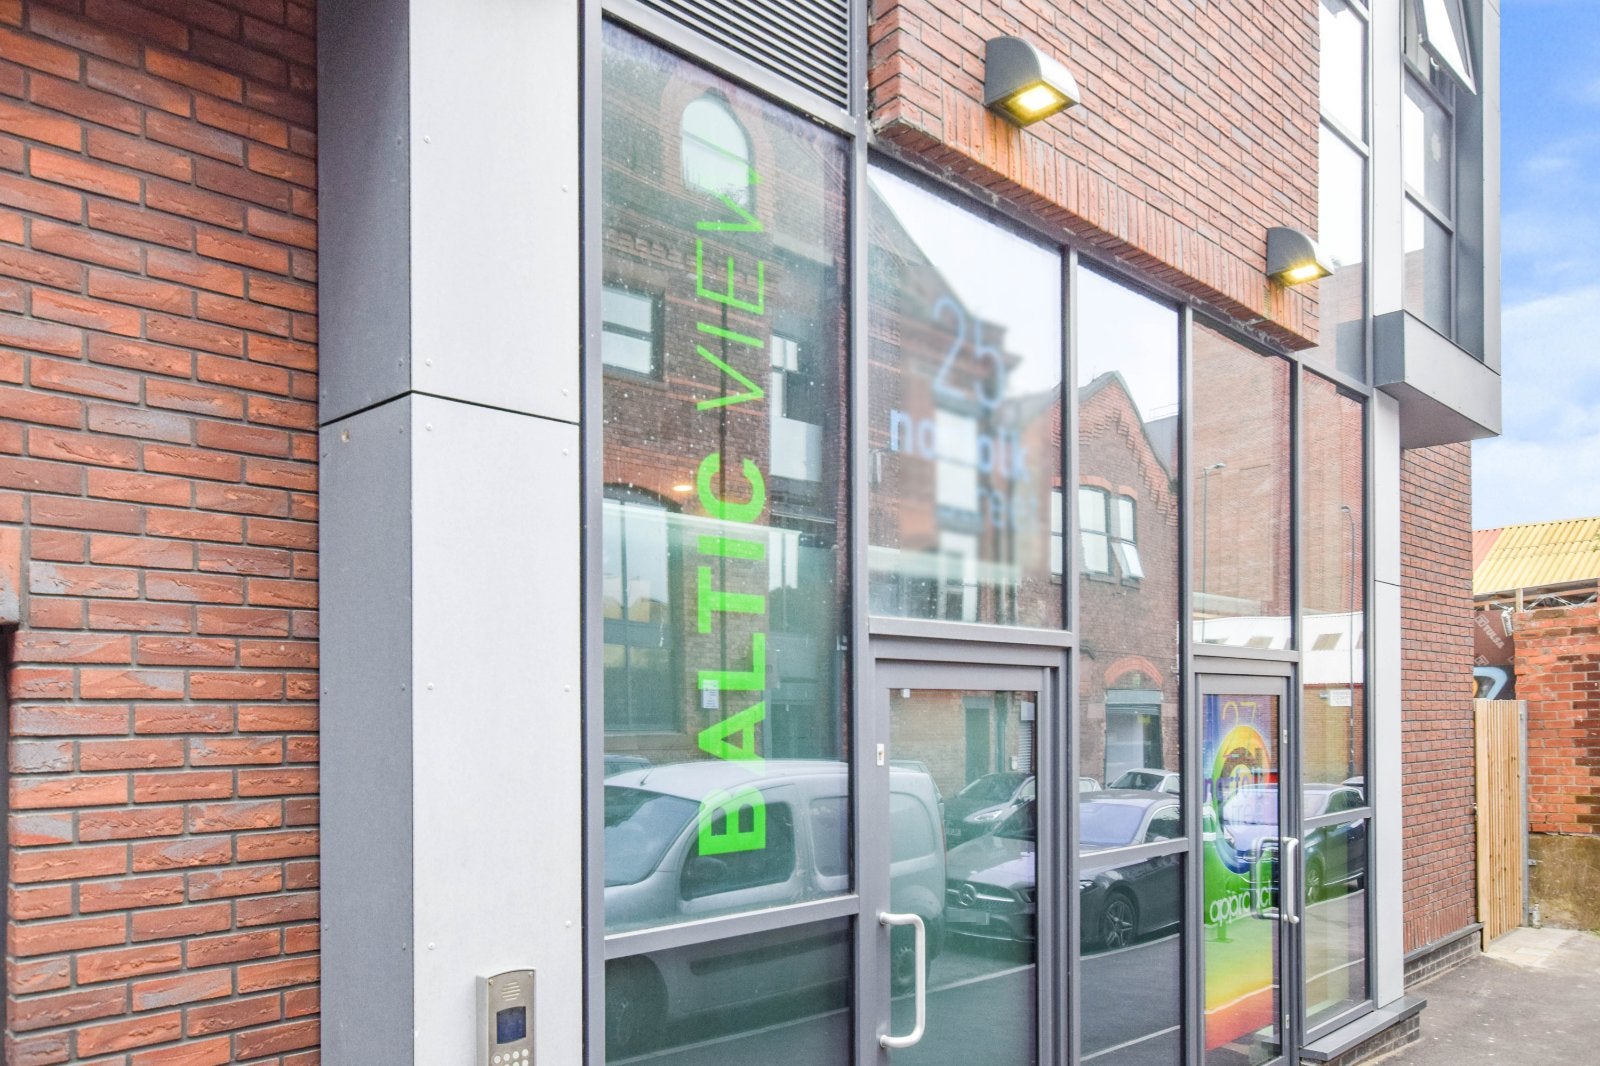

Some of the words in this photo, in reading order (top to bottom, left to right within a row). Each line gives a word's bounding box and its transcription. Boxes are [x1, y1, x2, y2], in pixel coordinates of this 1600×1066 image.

[931, 295, 1007, 409] 25
[890, 408, 1032, 484] noolk
[697, 452, 766, 856] BALTIC
[1209, 880, 1272, 927] approc
